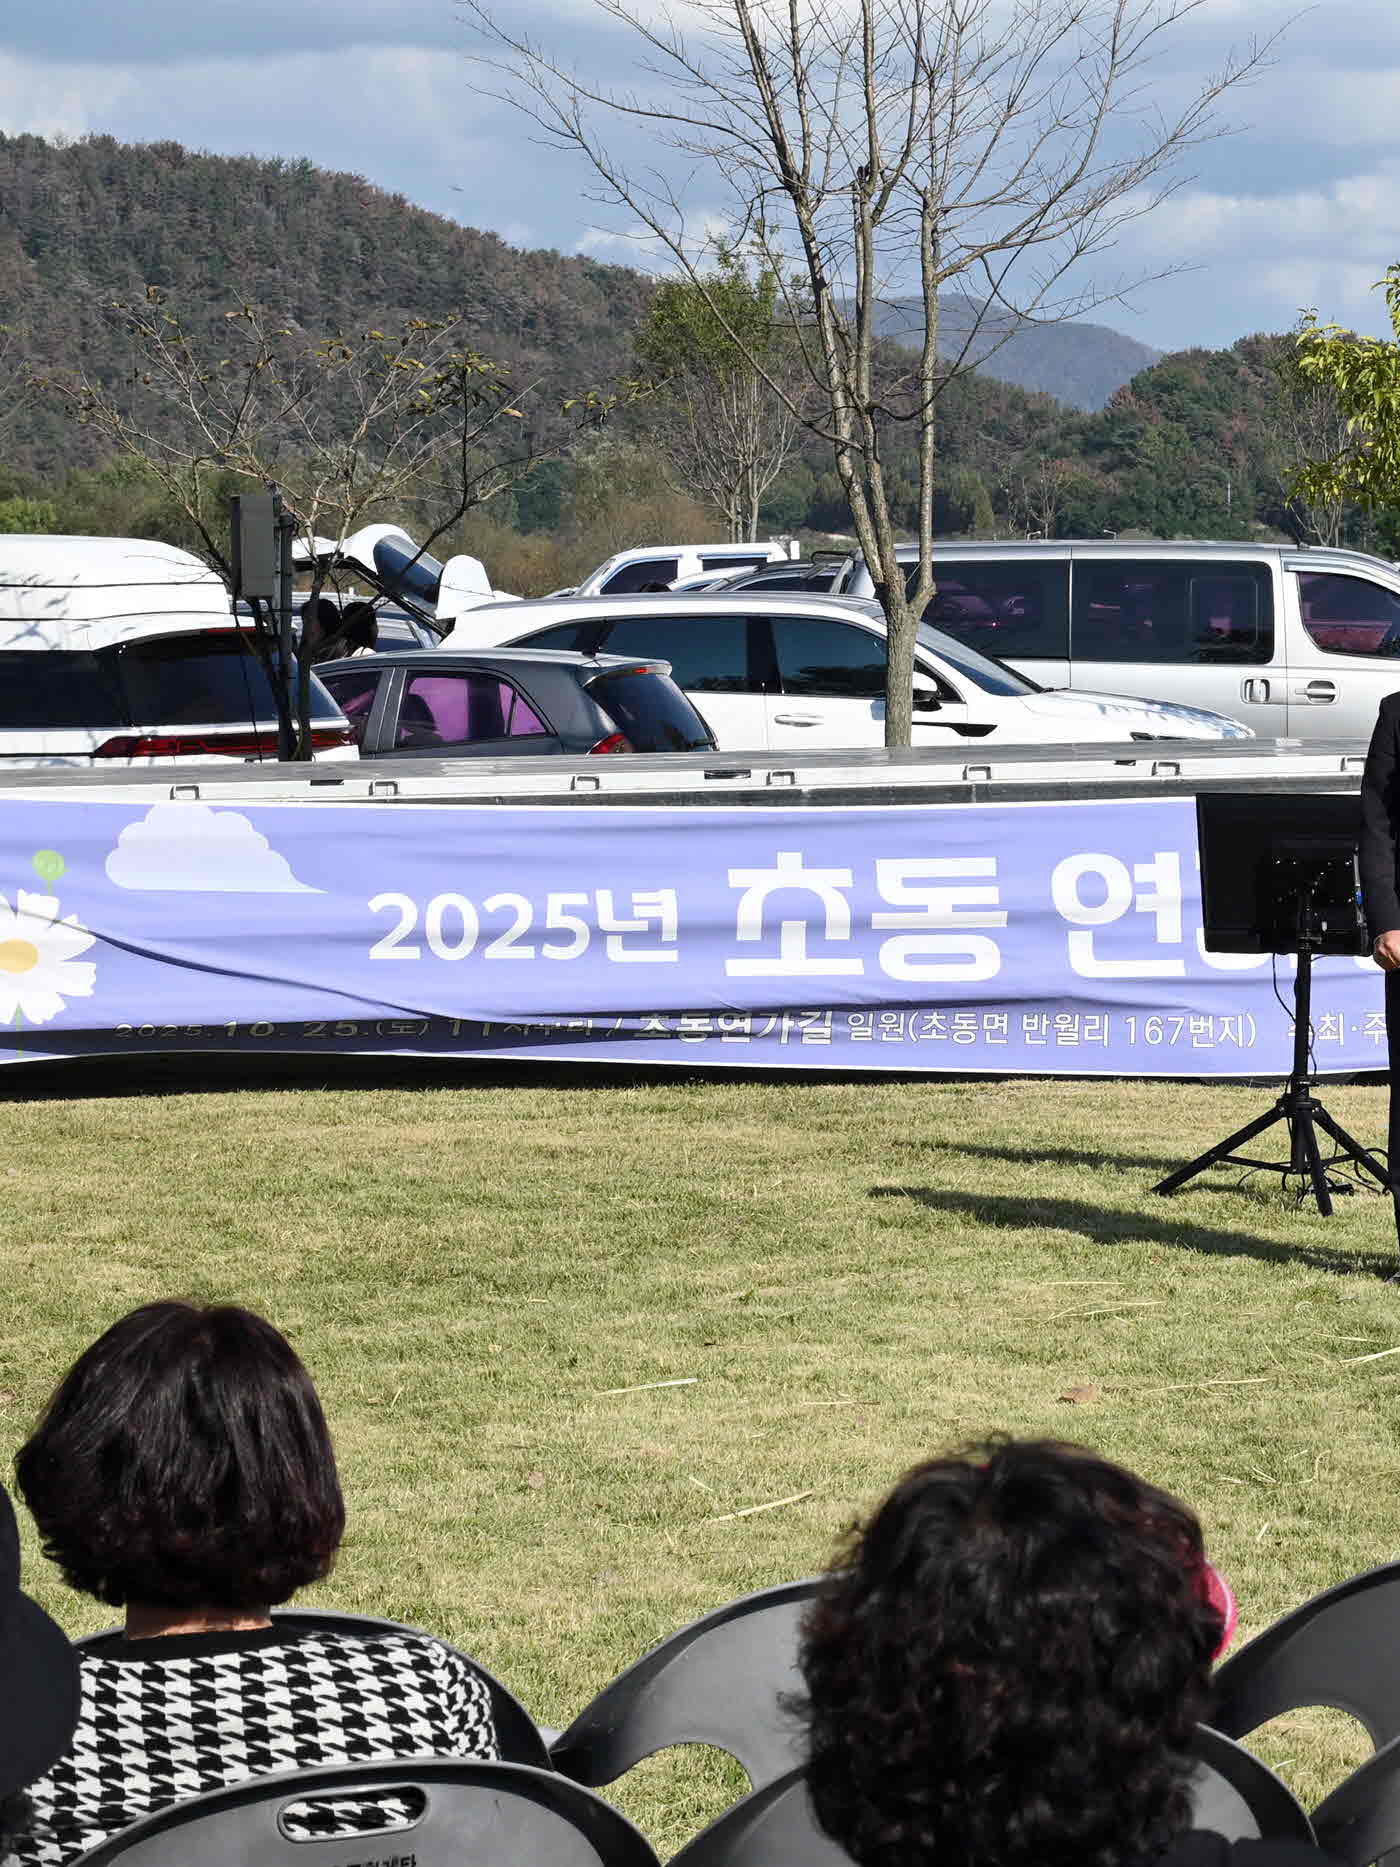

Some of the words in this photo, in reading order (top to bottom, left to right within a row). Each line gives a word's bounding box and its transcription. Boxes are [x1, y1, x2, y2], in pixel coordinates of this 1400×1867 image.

[367, 889, 678, 962] 2025년
[726, 852, 1008, 981] 초동
[633, 1008, 833, 1046] 초동연가길
[848, 1010, 1008, 1045] 일원(초동면
[1022, 1014, 1110, 1047] 반월리
[1124, 1014, 1257, 1049] 167번지)
